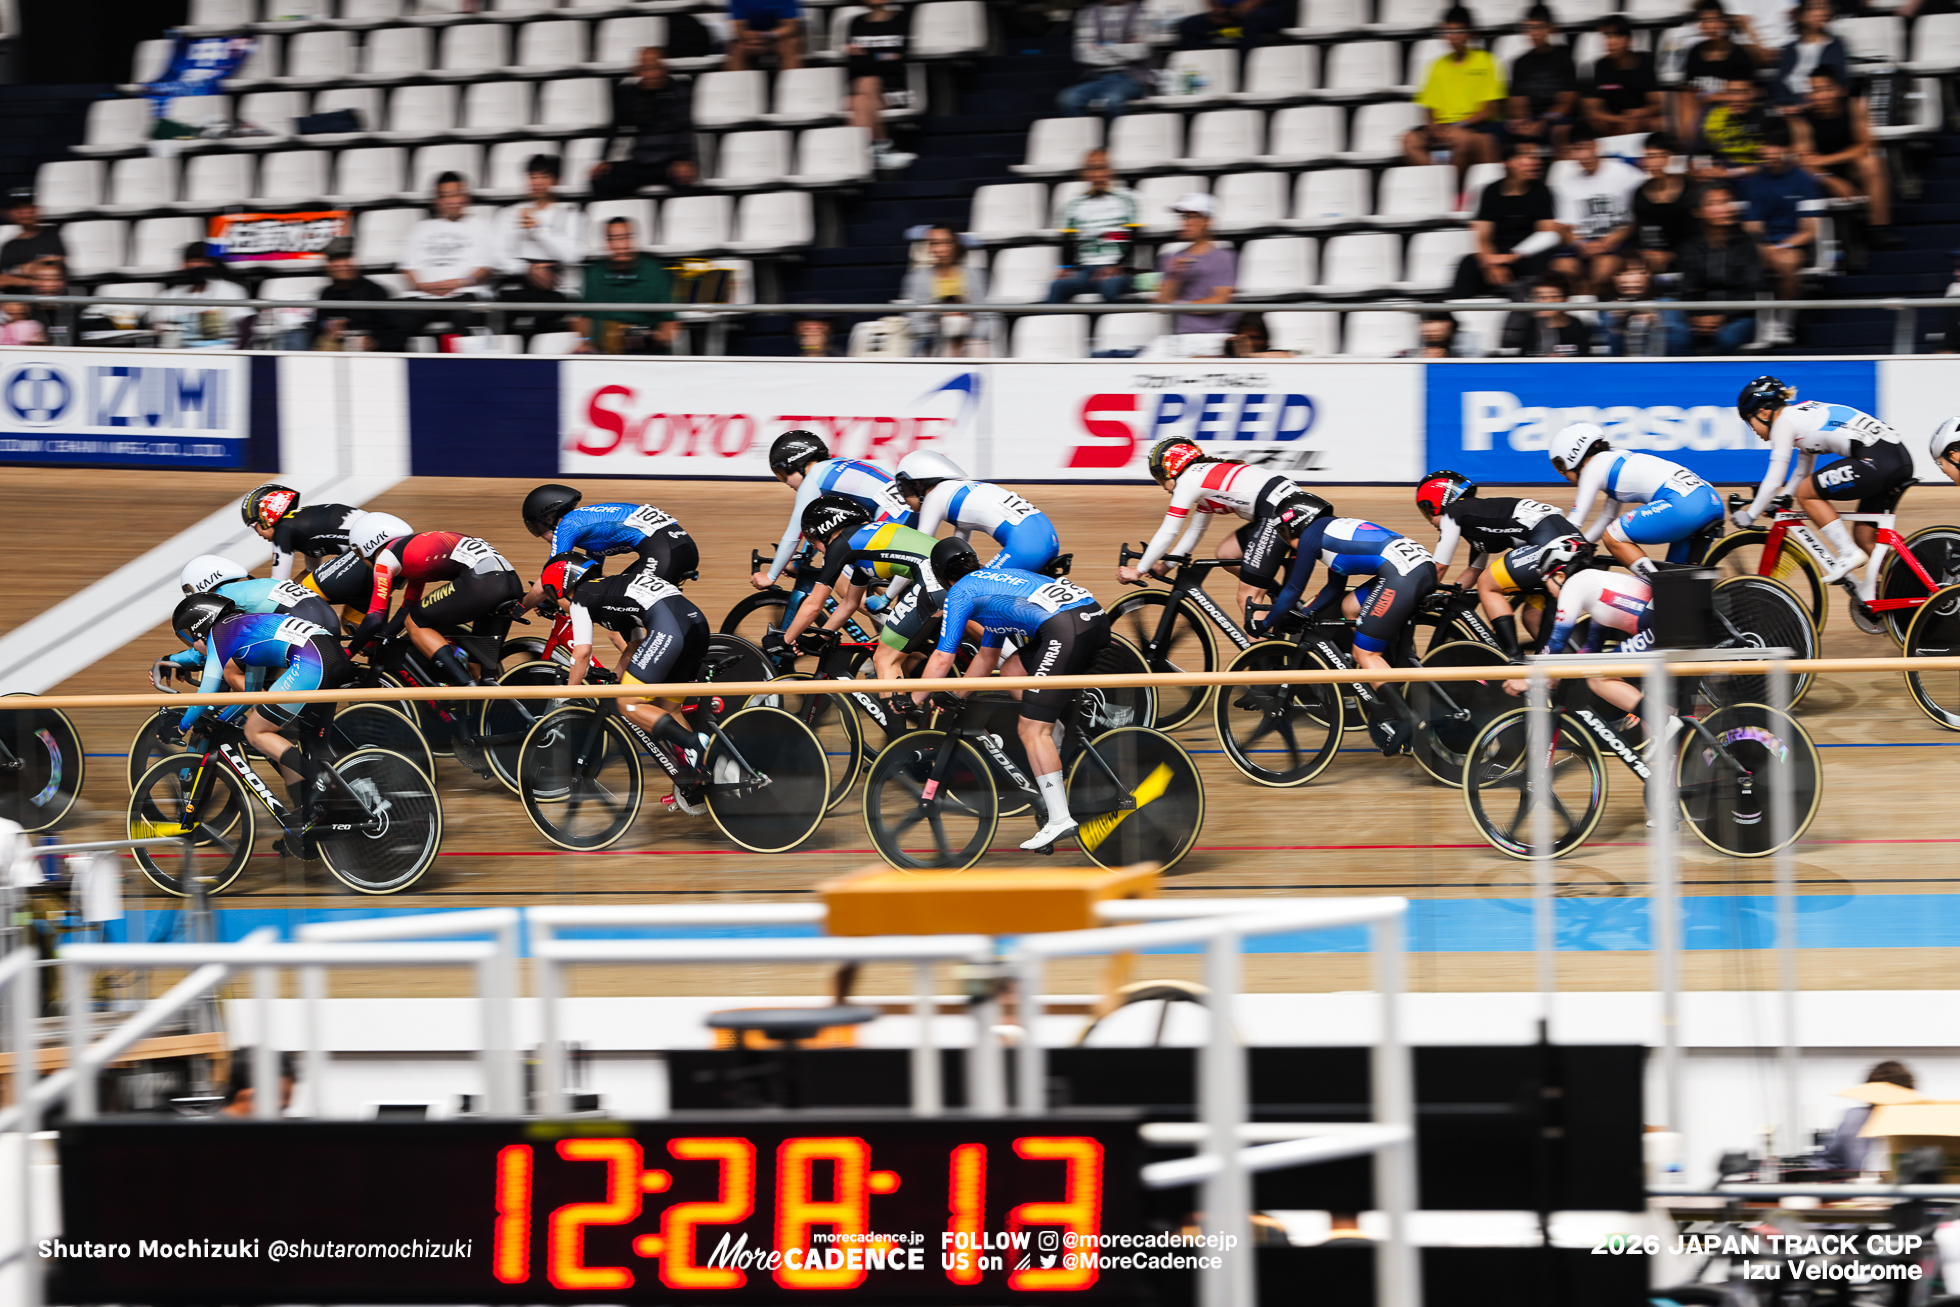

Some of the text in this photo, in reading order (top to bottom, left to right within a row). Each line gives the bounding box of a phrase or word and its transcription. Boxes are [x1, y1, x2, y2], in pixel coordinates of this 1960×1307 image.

[565, 384, 752, 458] SOYO
[1062, 393, 1322, 468] SPEED
[1855, 417, 1881, 434] 115
[1567, 435, 1587, 462] KASK
[1674, 470, 1700, 486] 113
[1003, 495, 1030, 515] 112
[1522, 500, 1552, 512] 119
[636, 508, 667, 529] 107
[817, 512, 847, 534] KASK
[363, 531, 388, 552] KASK
[461, 540, 488, 555] 101
[1395, 542, 1422, 562] 121
[196, 570, 223, 591] KASK
[377, 577, 388, 600] ANTA
[633, 576, 664, 592] 120
[970, 571, 1029, 586] CCACHE
[279, 582, 308, 598] 103
[421, 582, 456, 609] CHINA
[1042, 585, 1074, 603] 109
[602, 605, 640, 613] ANCHOR
[1187, 587, 1251, 650] BRIDGESTONE
[284, 618, 314, 634] 111
[1316, 641, 1373, 702] BRIDGONE
[1575, 710, 1638, 763] ARGON
[976, 735, 1038, 794] RIDLEY
[220, 744, 284, 810] LOOK
